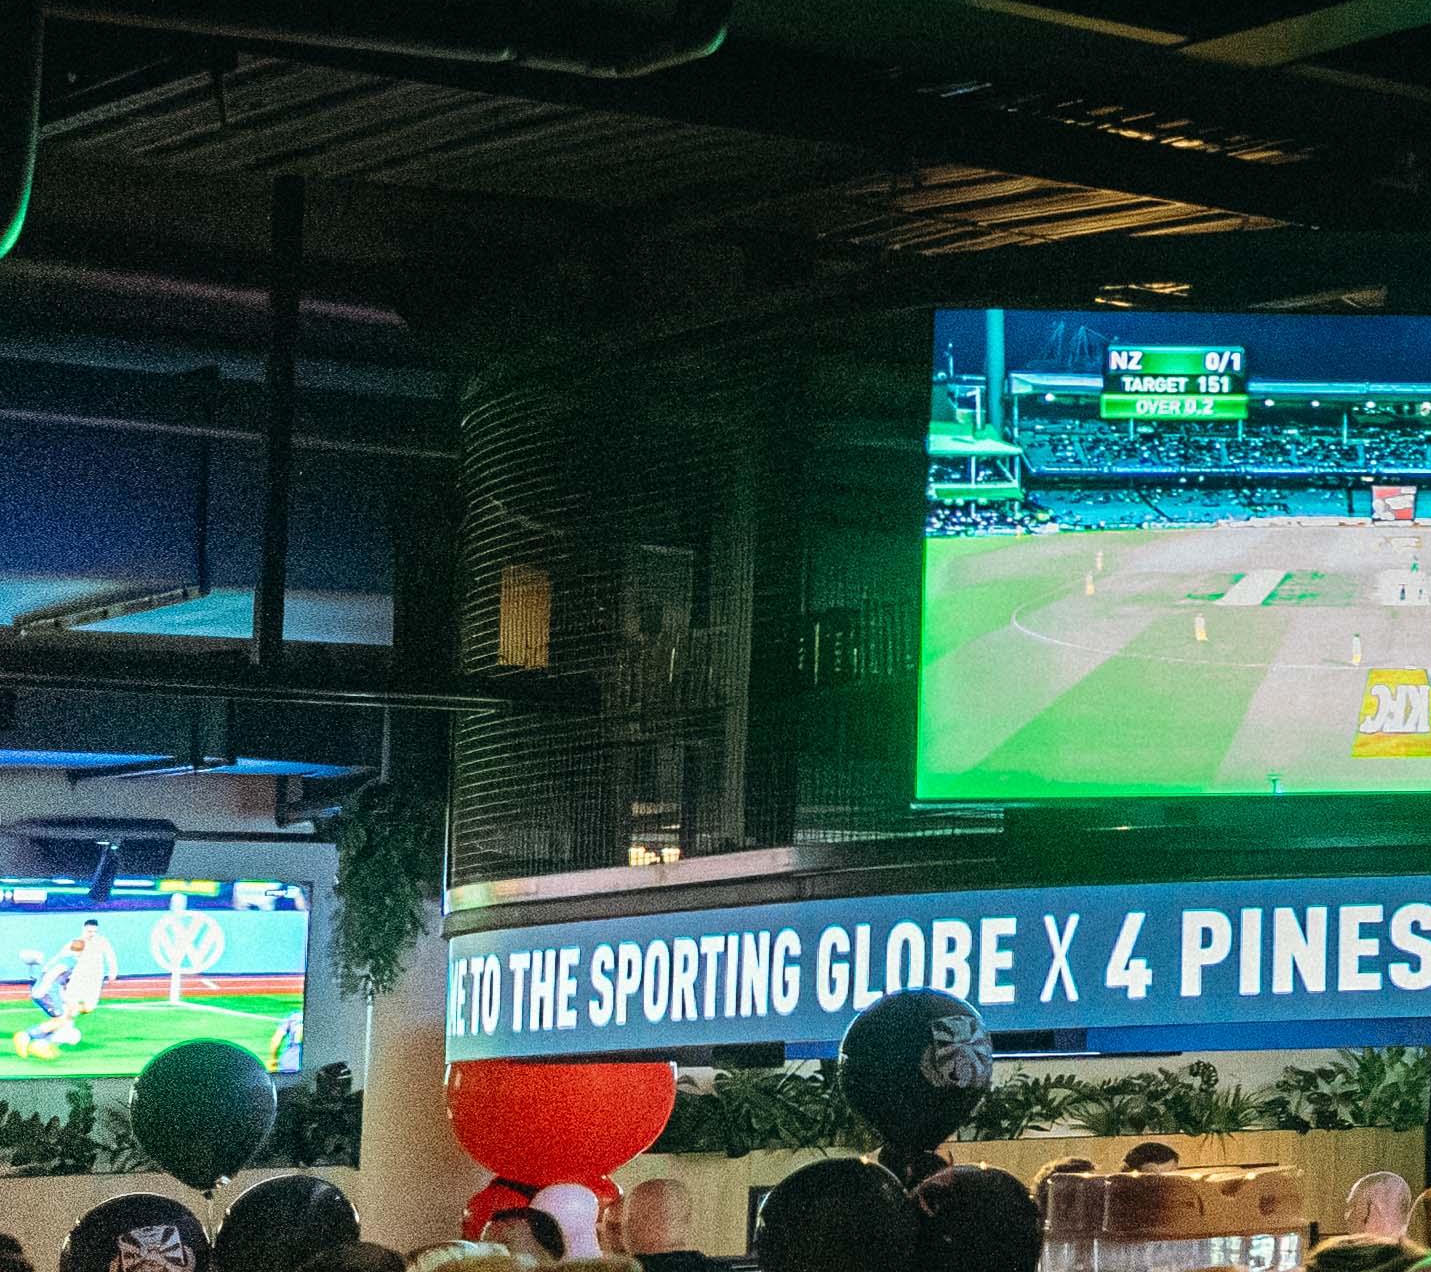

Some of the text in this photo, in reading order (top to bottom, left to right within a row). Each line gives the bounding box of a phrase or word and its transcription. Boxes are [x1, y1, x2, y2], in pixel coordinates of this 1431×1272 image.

[1110, 351, 1241, 373] NZ 0/1
[1122, 376, 1230, 393] TARGET 151
[1136, 399, 1182, 415] OVER
[470, 953, 501, 1036] TO
[509, 947, 581, 1032] THE
[588, 930, 803, 1027] SPORTING
[816, 917, 1017, 1012] GLOBE
[1040, 914, 1079, 1003] X
[1106, 912, 1153, 999] 4
